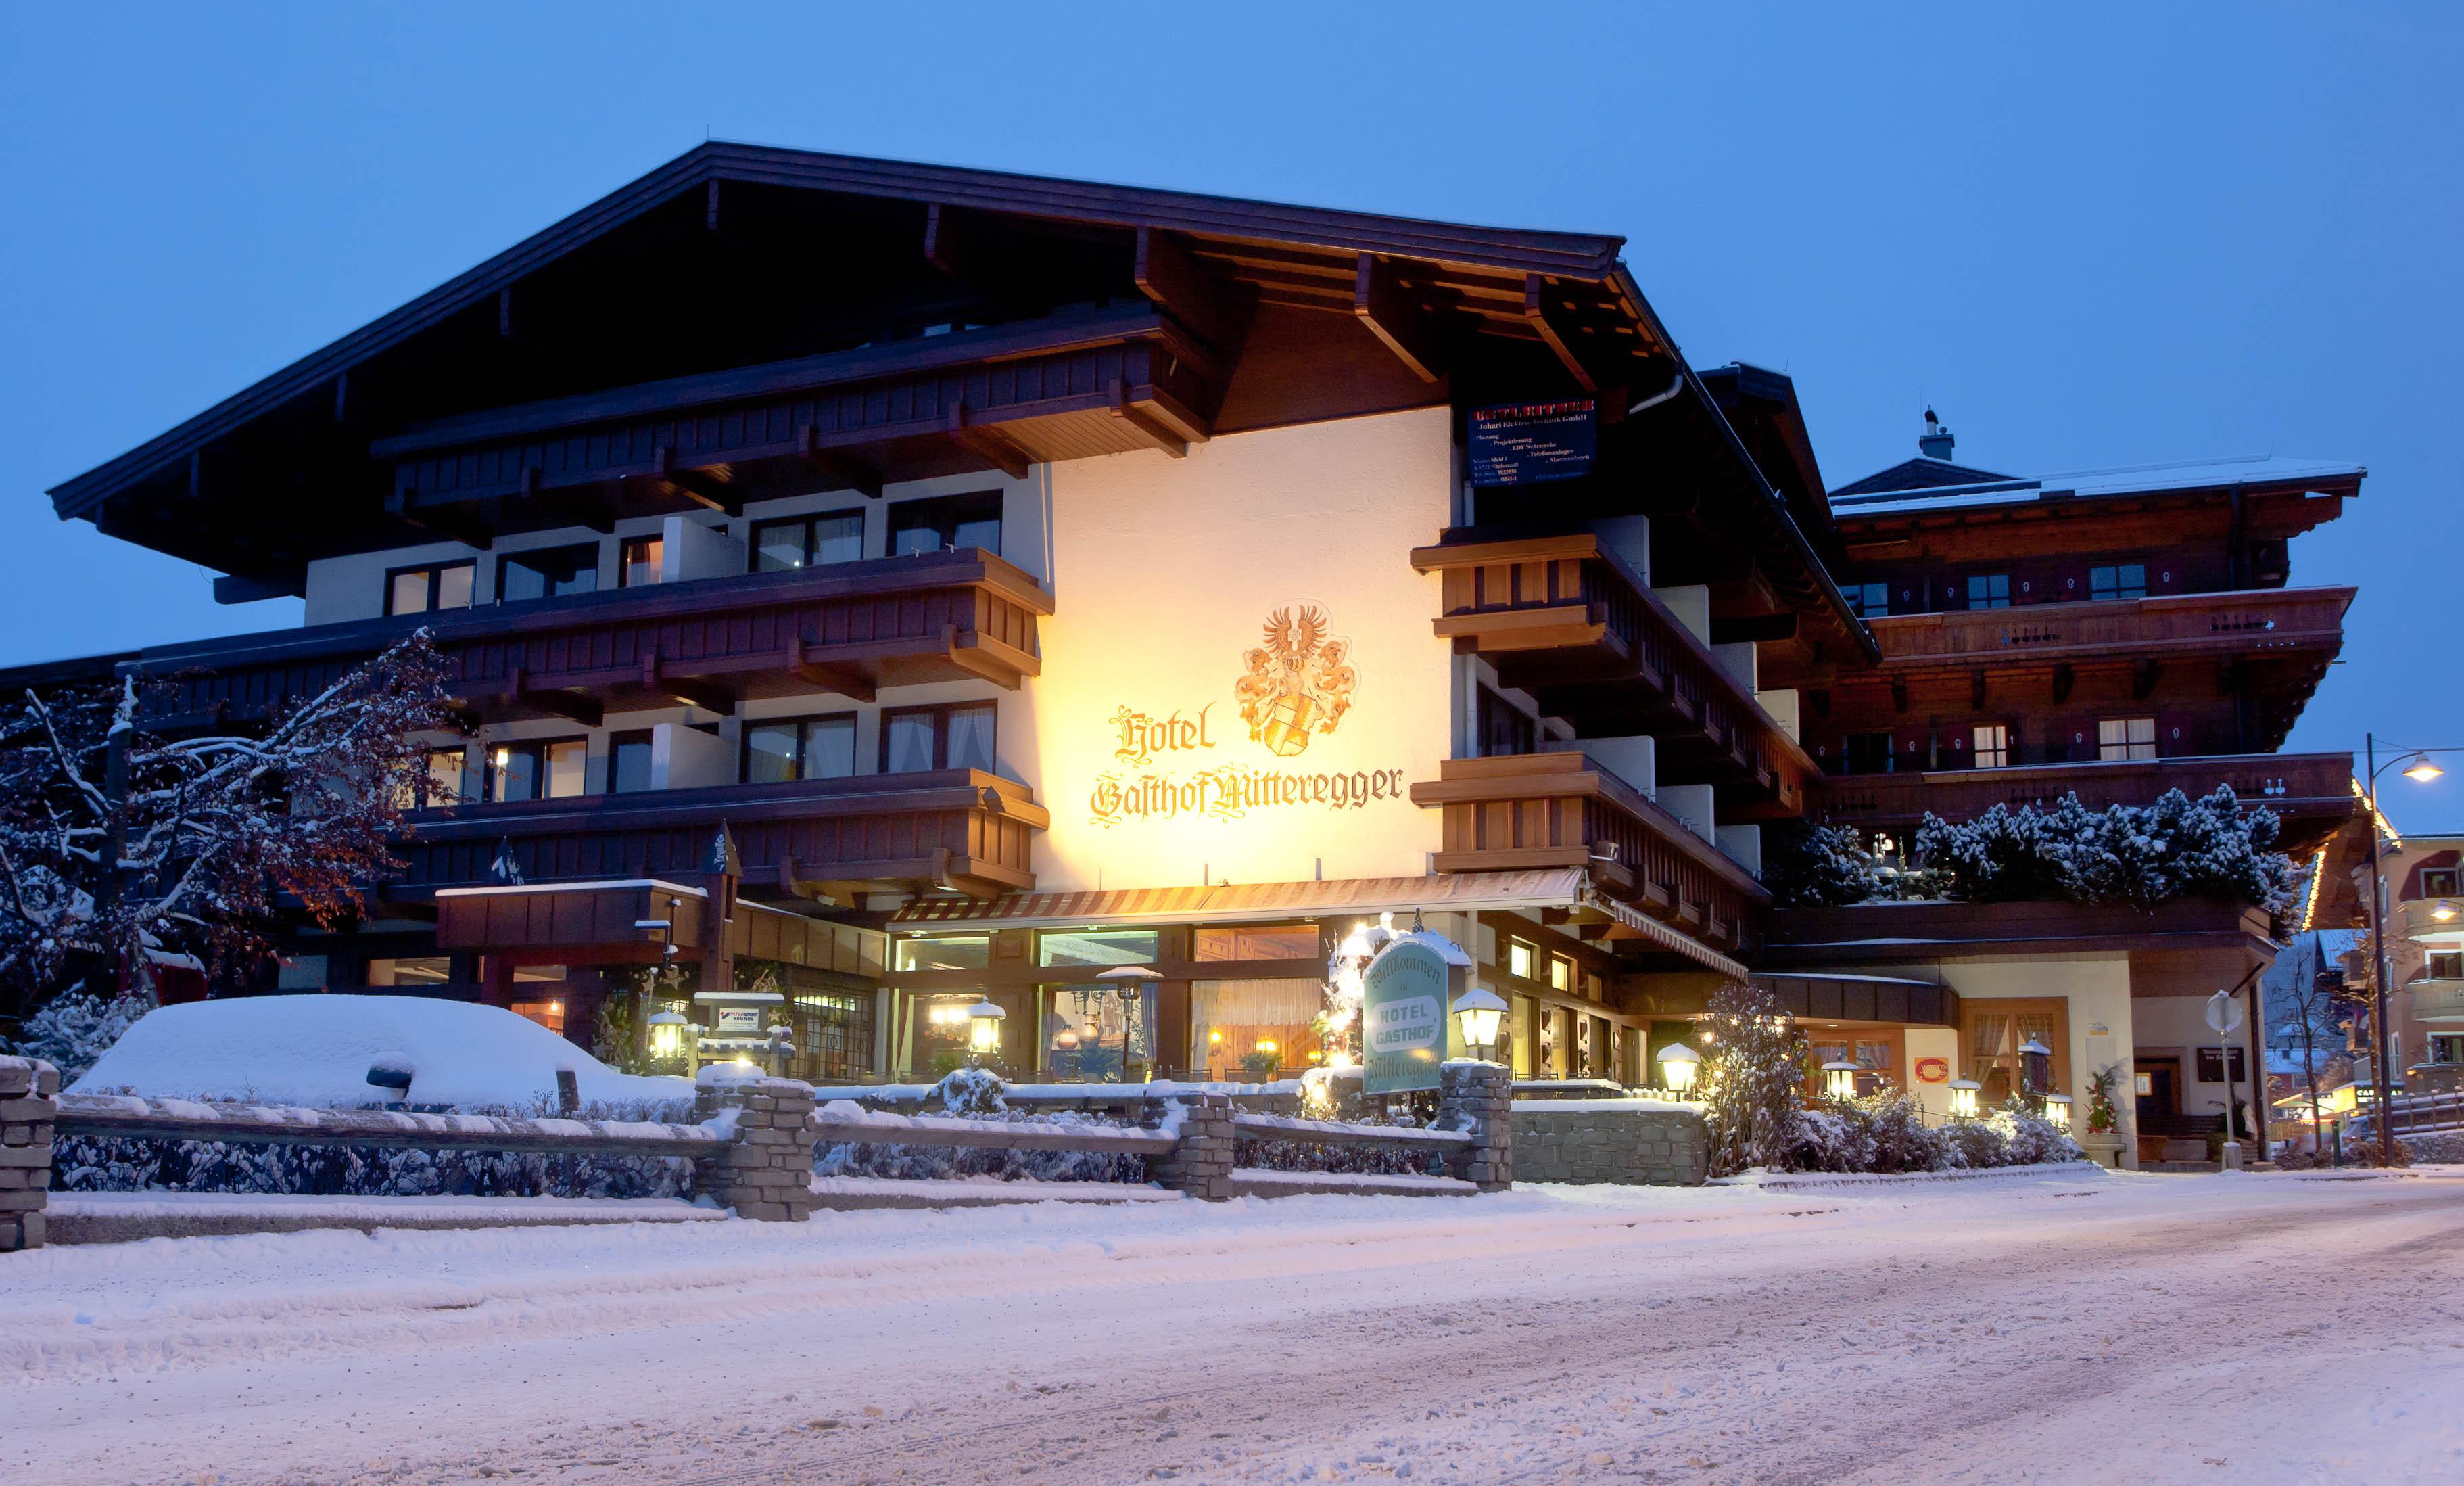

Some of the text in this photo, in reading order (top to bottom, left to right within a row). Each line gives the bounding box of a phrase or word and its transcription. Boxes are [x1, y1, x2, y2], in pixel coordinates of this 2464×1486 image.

[1478, 421, 1502, 431] Johari
[1562, 414, 1587, 423] GmbH
[1109, 701, 1217, 768] Hotel
[1209, 762, 1404, 822] Mitteregger
[1370, 954, 1440, 992] Willkommen
[1380, 1004, 1429, 1024] HOTEL
[1375, 1025, 1434, 1045] GASTHOF
